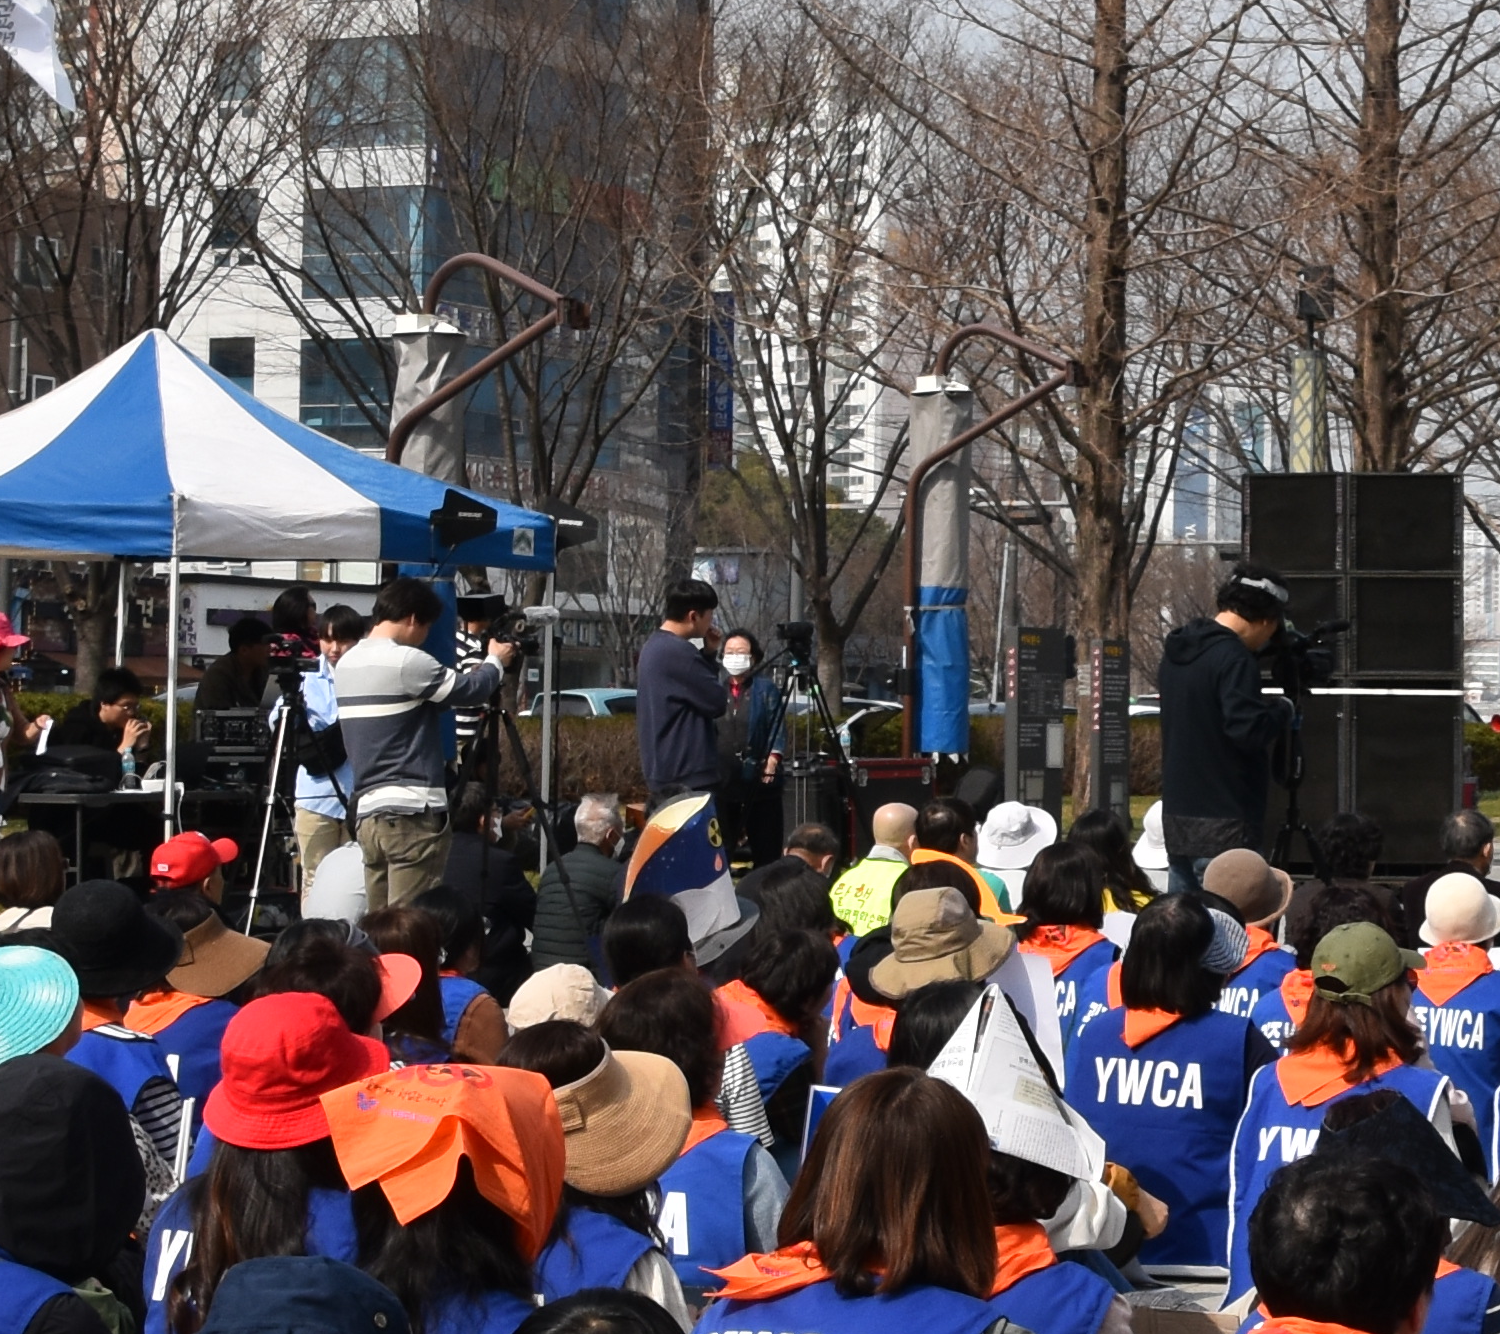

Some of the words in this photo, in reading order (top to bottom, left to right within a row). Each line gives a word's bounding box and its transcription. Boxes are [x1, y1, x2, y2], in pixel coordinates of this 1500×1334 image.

[1053, 980, 1077, 1017] CA
[1218, 987, 1259, 1018] WCA
[1094, 1056, 1204, 1110] YWCA
[1257, 1125, 1321, 1163] YW
